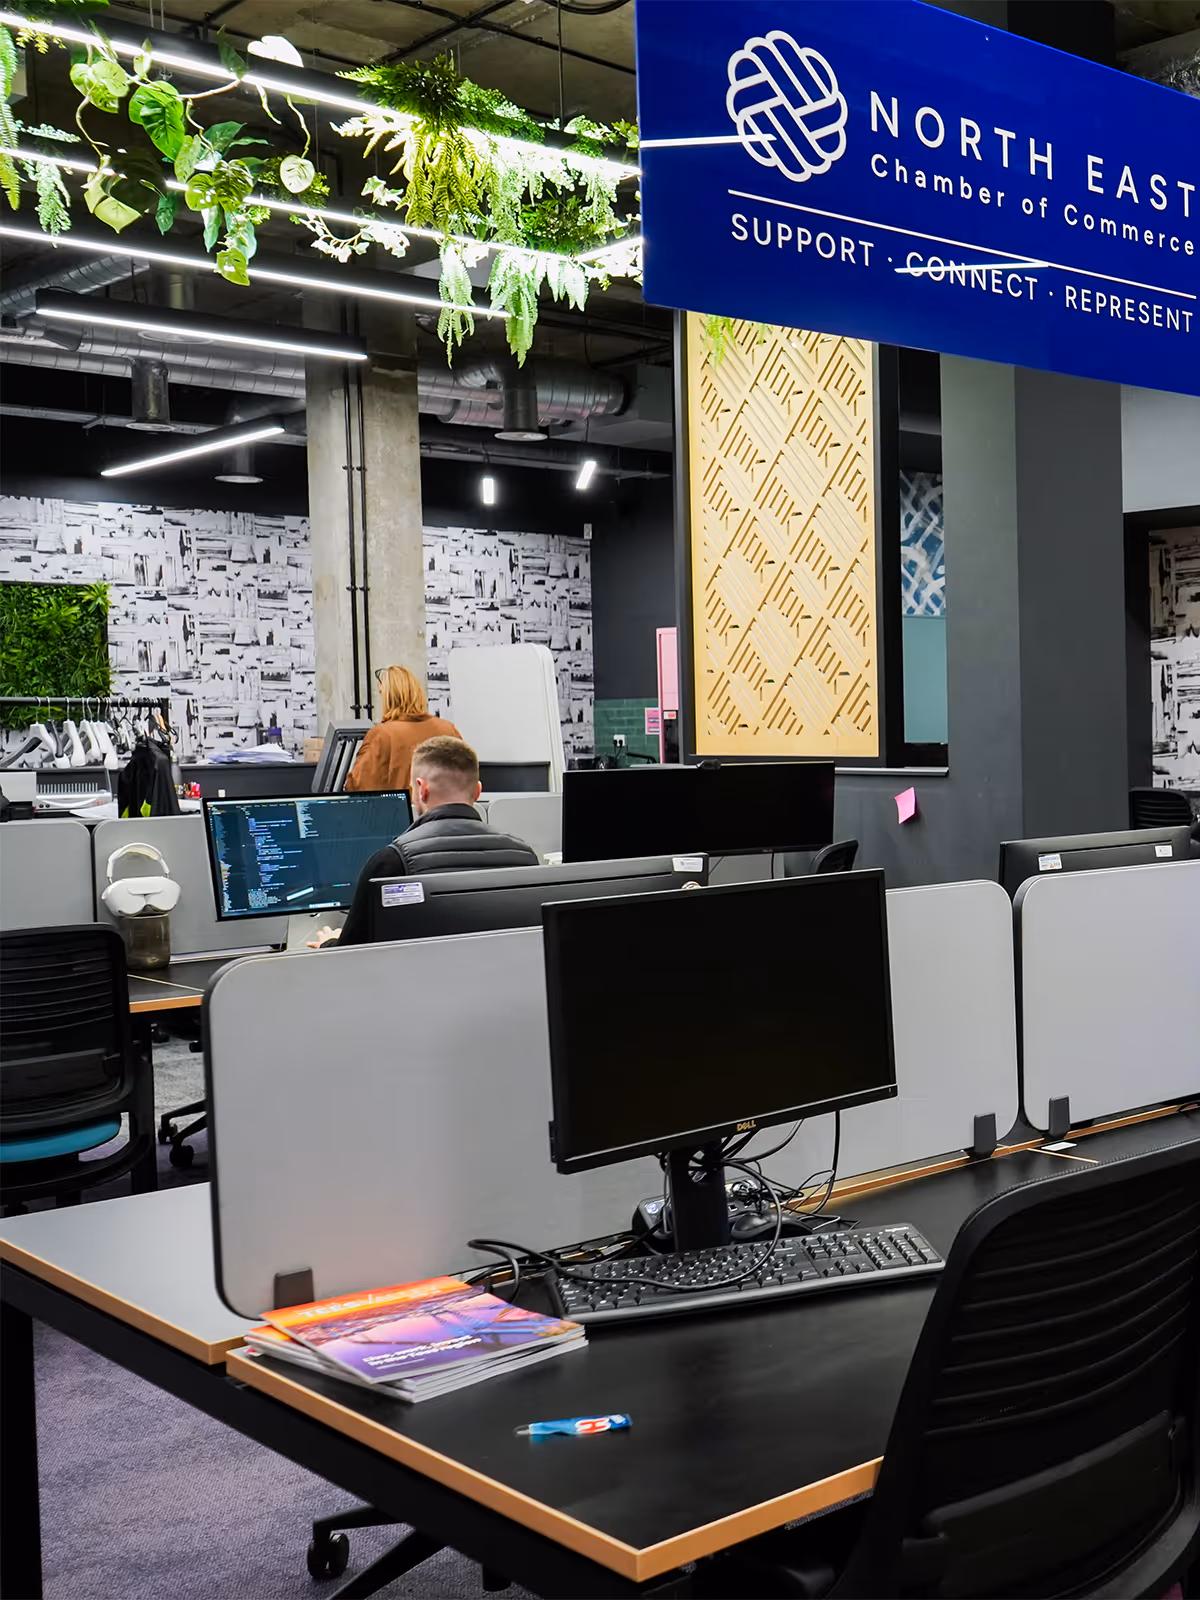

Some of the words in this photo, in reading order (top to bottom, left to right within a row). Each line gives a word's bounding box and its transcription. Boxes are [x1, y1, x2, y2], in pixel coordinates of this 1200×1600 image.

[869, 90, 1053, 180] NORTH
[1087, 153, 1197, 218] EAST
[870, 153, 1006, 208] Chamber
[1021, 195, 1050, 219] of
[1063, 204, 1195, 256] Commerce
[730, 212, 875, 268] SUPPORT
[905, 251, 1038, 301] CONNECT
[1065, 285, 1194, 334] REPRESENT
[737, 1120, 757, 1131] DELL
